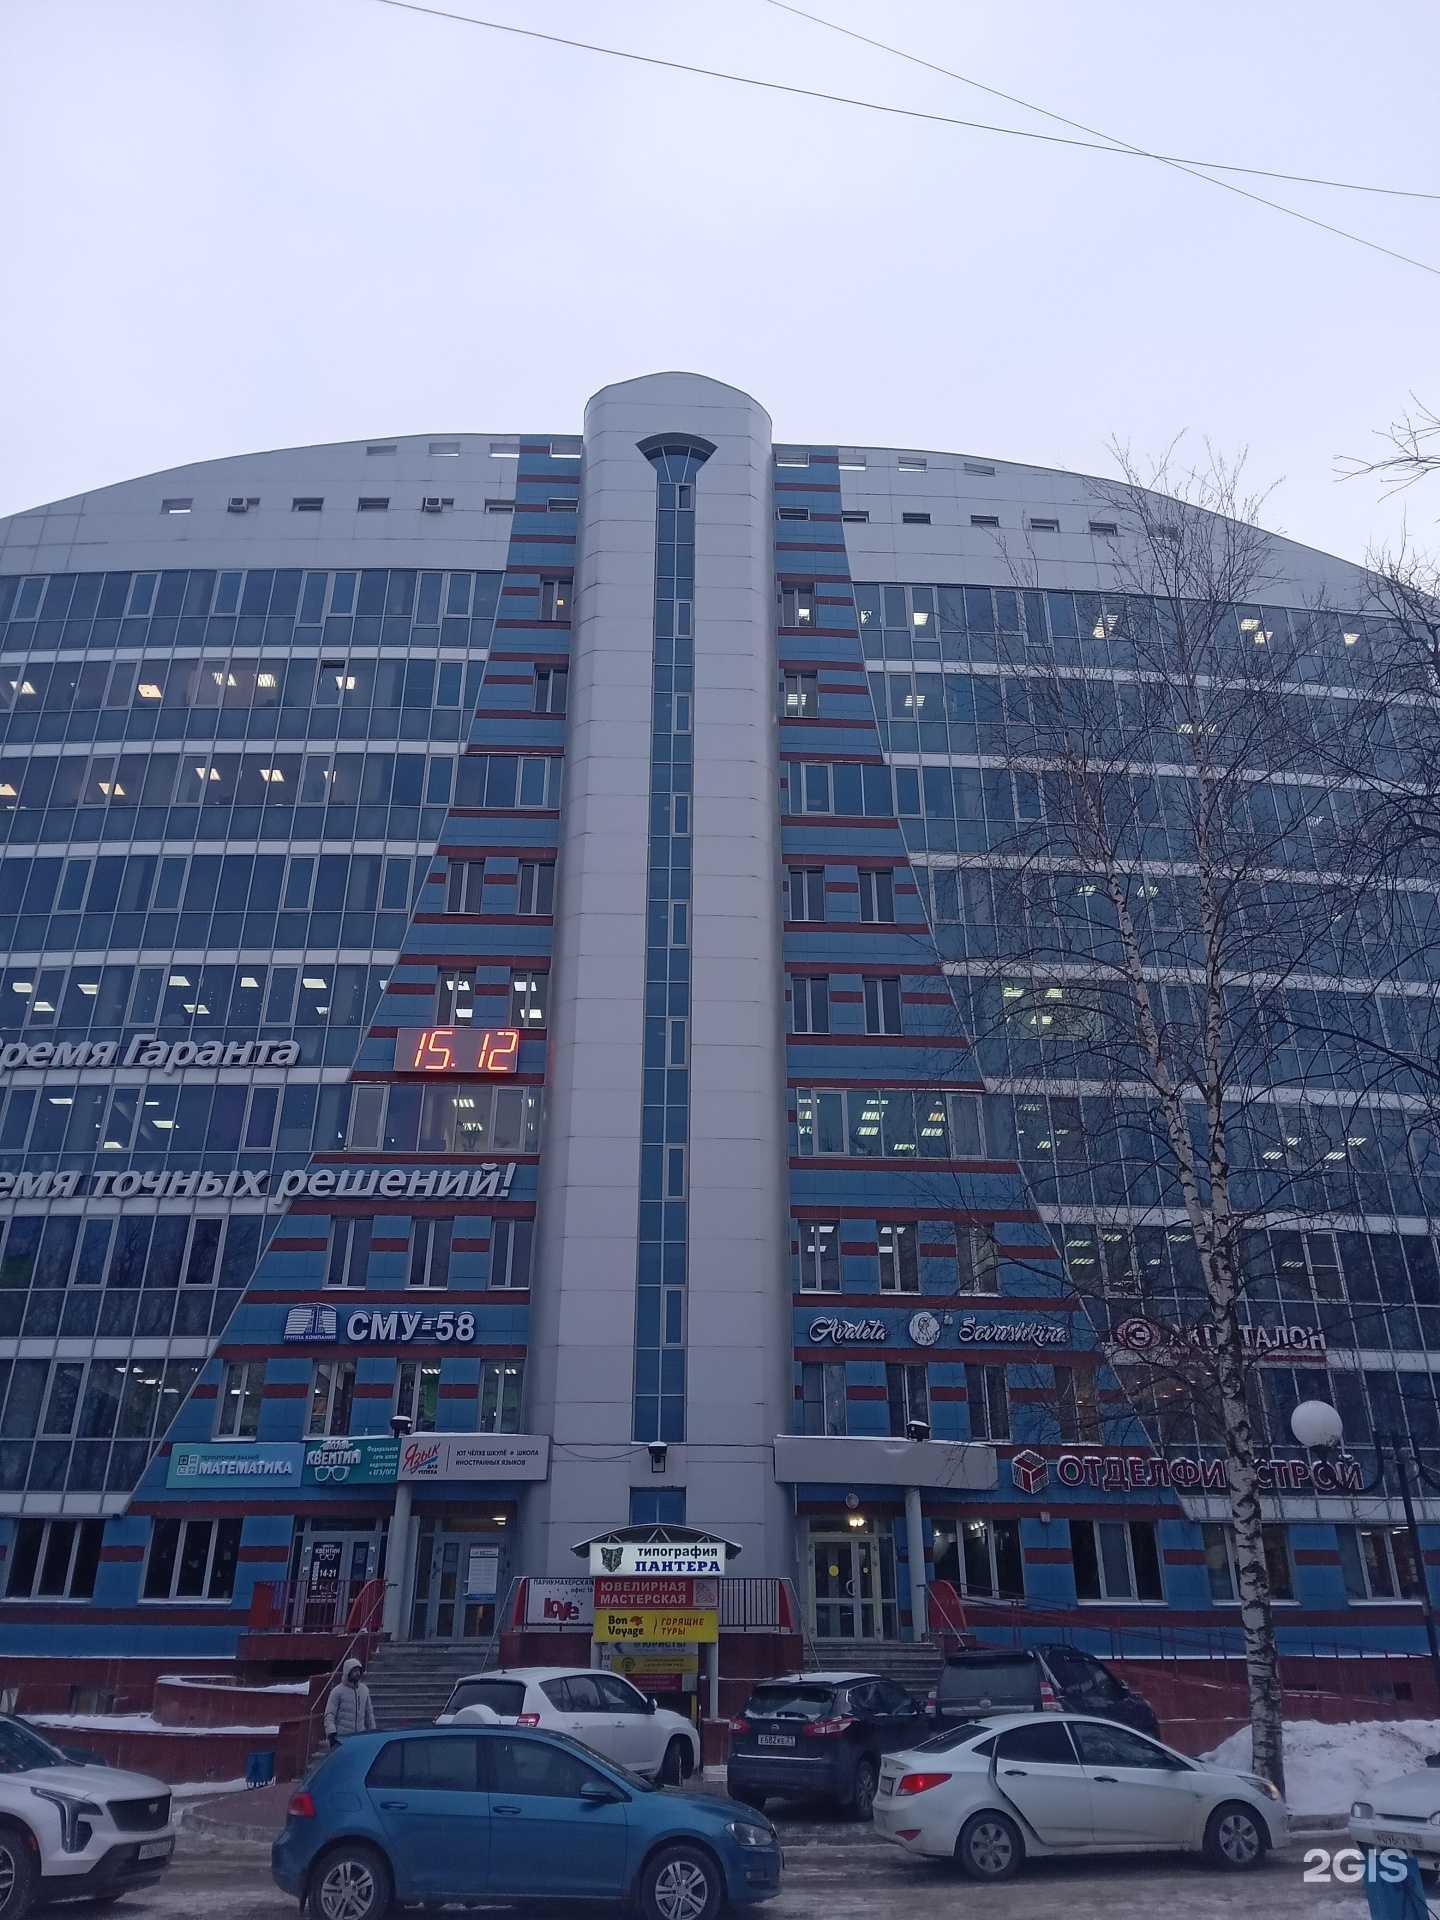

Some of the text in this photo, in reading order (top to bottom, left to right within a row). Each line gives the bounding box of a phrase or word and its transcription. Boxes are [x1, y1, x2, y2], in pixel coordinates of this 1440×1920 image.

[0, 1033, 301, 1077] ремя Гаранта
[93, 1168, 269, 1199] точных
[275, 1162, 517, 1207] решений!
[346, 1310, 477, 1342] СМУ-58
[1218, 1324, 1327, 1350] ТАЛОН
[199, 1461, 293, 1475] МАТЕМАТИКА
[1057, 1454, 1364, 1492] ОТДЕЛФИСТРОЙ
[638, 1546, 718, 1559] типография
[635, 1561, 720, 1572] ПАНТЕРА
[601, 1582, 687, 1592] ЮВЕЛИРНАЯ
[601, 1594, 687, 1605] МАСТЕРСКАЯ
[608, 1616, 628, 1625] Bon
[661, 1617, 704, 1626] ГОРЯЩИЕ
[608, 1626, 644, 1637] Voyage
